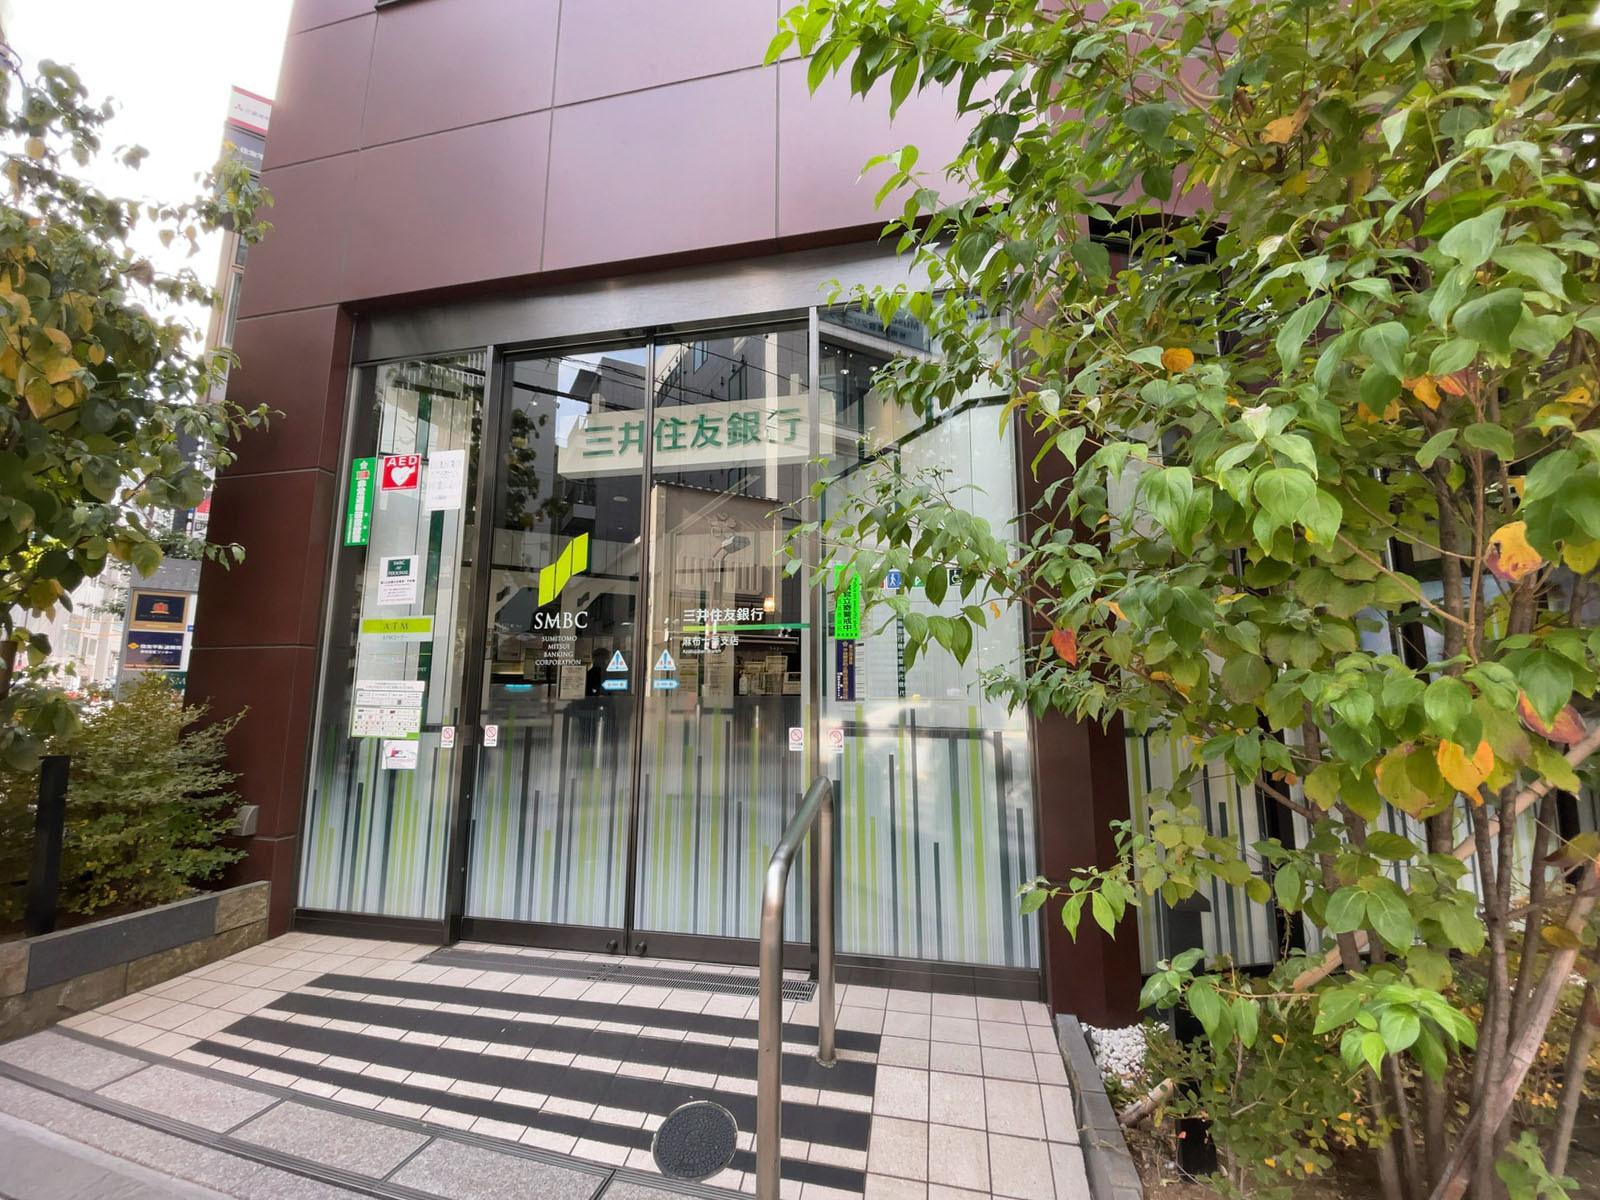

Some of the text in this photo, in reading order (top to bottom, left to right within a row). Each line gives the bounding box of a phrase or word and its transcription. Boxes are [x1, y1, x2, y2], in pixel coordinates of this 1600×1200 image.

[583, 408, 801, 456] 三井住友銀行
[386, 456, 418, 467] AED
[534, 611, 588, 629] SMBC
[683, 608, 764, 622] 三井住友銀行
[383, 622, 409, 630] ATM
